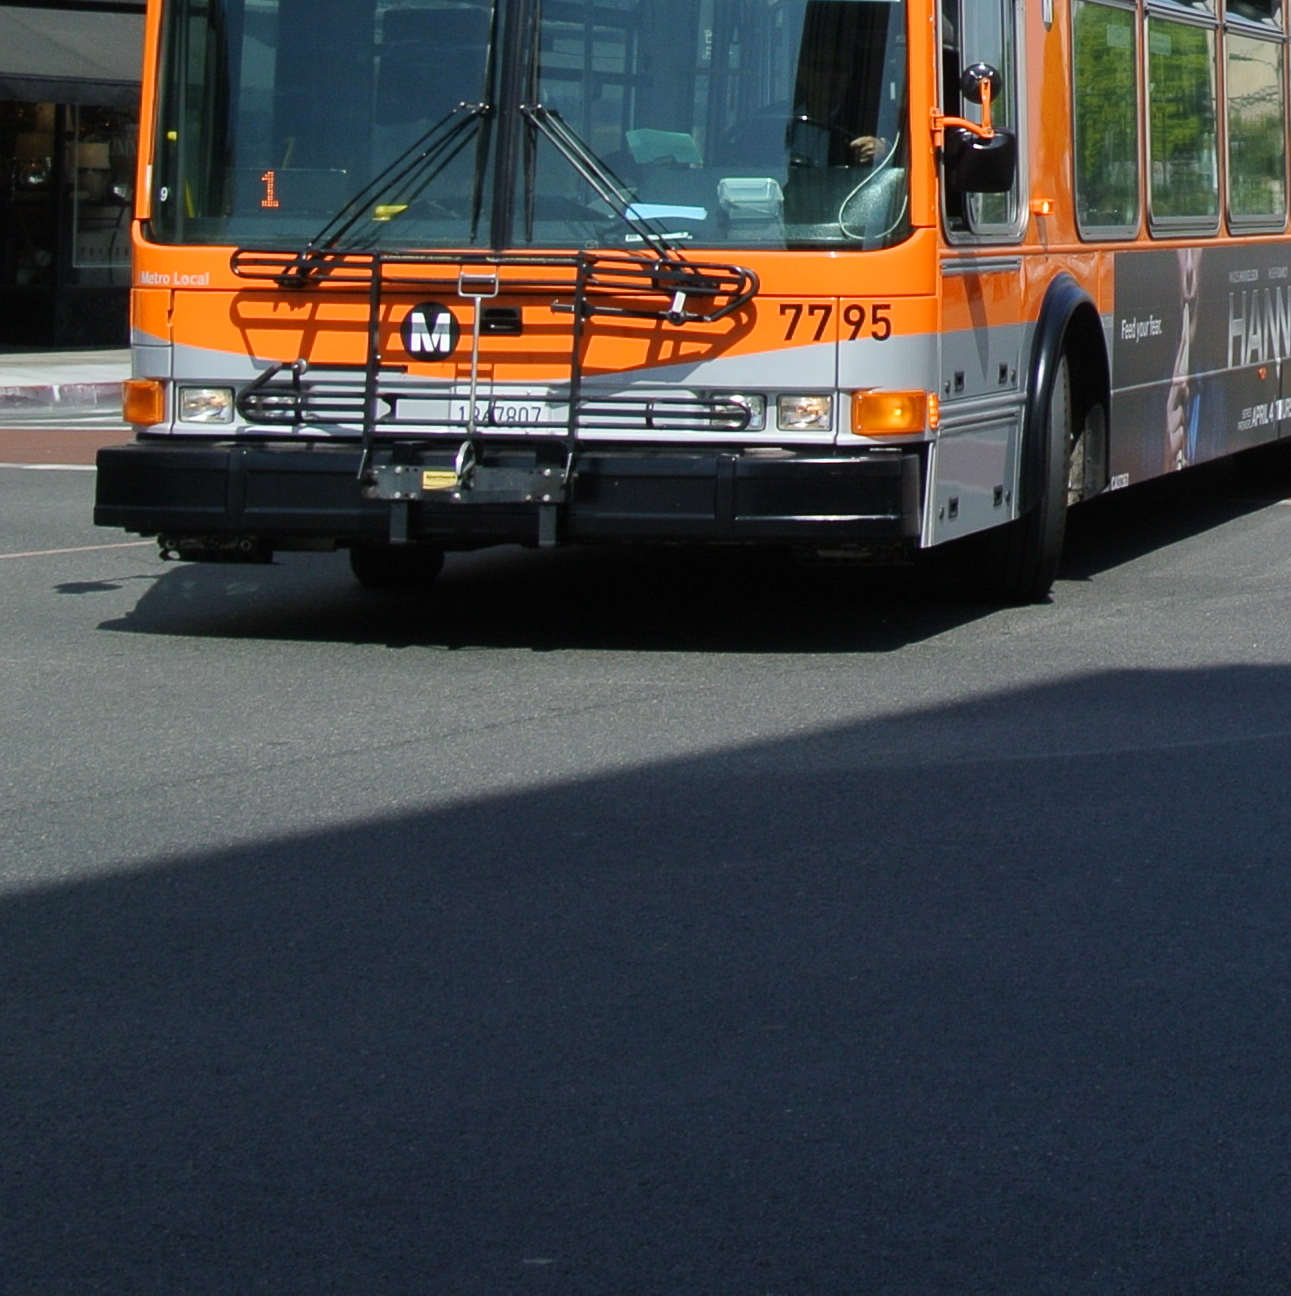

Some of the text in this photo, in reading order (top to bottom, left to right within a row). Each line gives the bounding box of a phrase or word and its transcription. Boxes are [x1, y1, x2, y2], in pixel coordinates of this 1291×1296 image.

[160, 186, 168, 202] 9
[261, 171, 279, 208] 1
[141, 271, 210, 286] Metro Local
[779, 304, 892, 341] 7795
[1121, 316, 1136, 340] Feed
[1136, 320, 1149, 344] your
